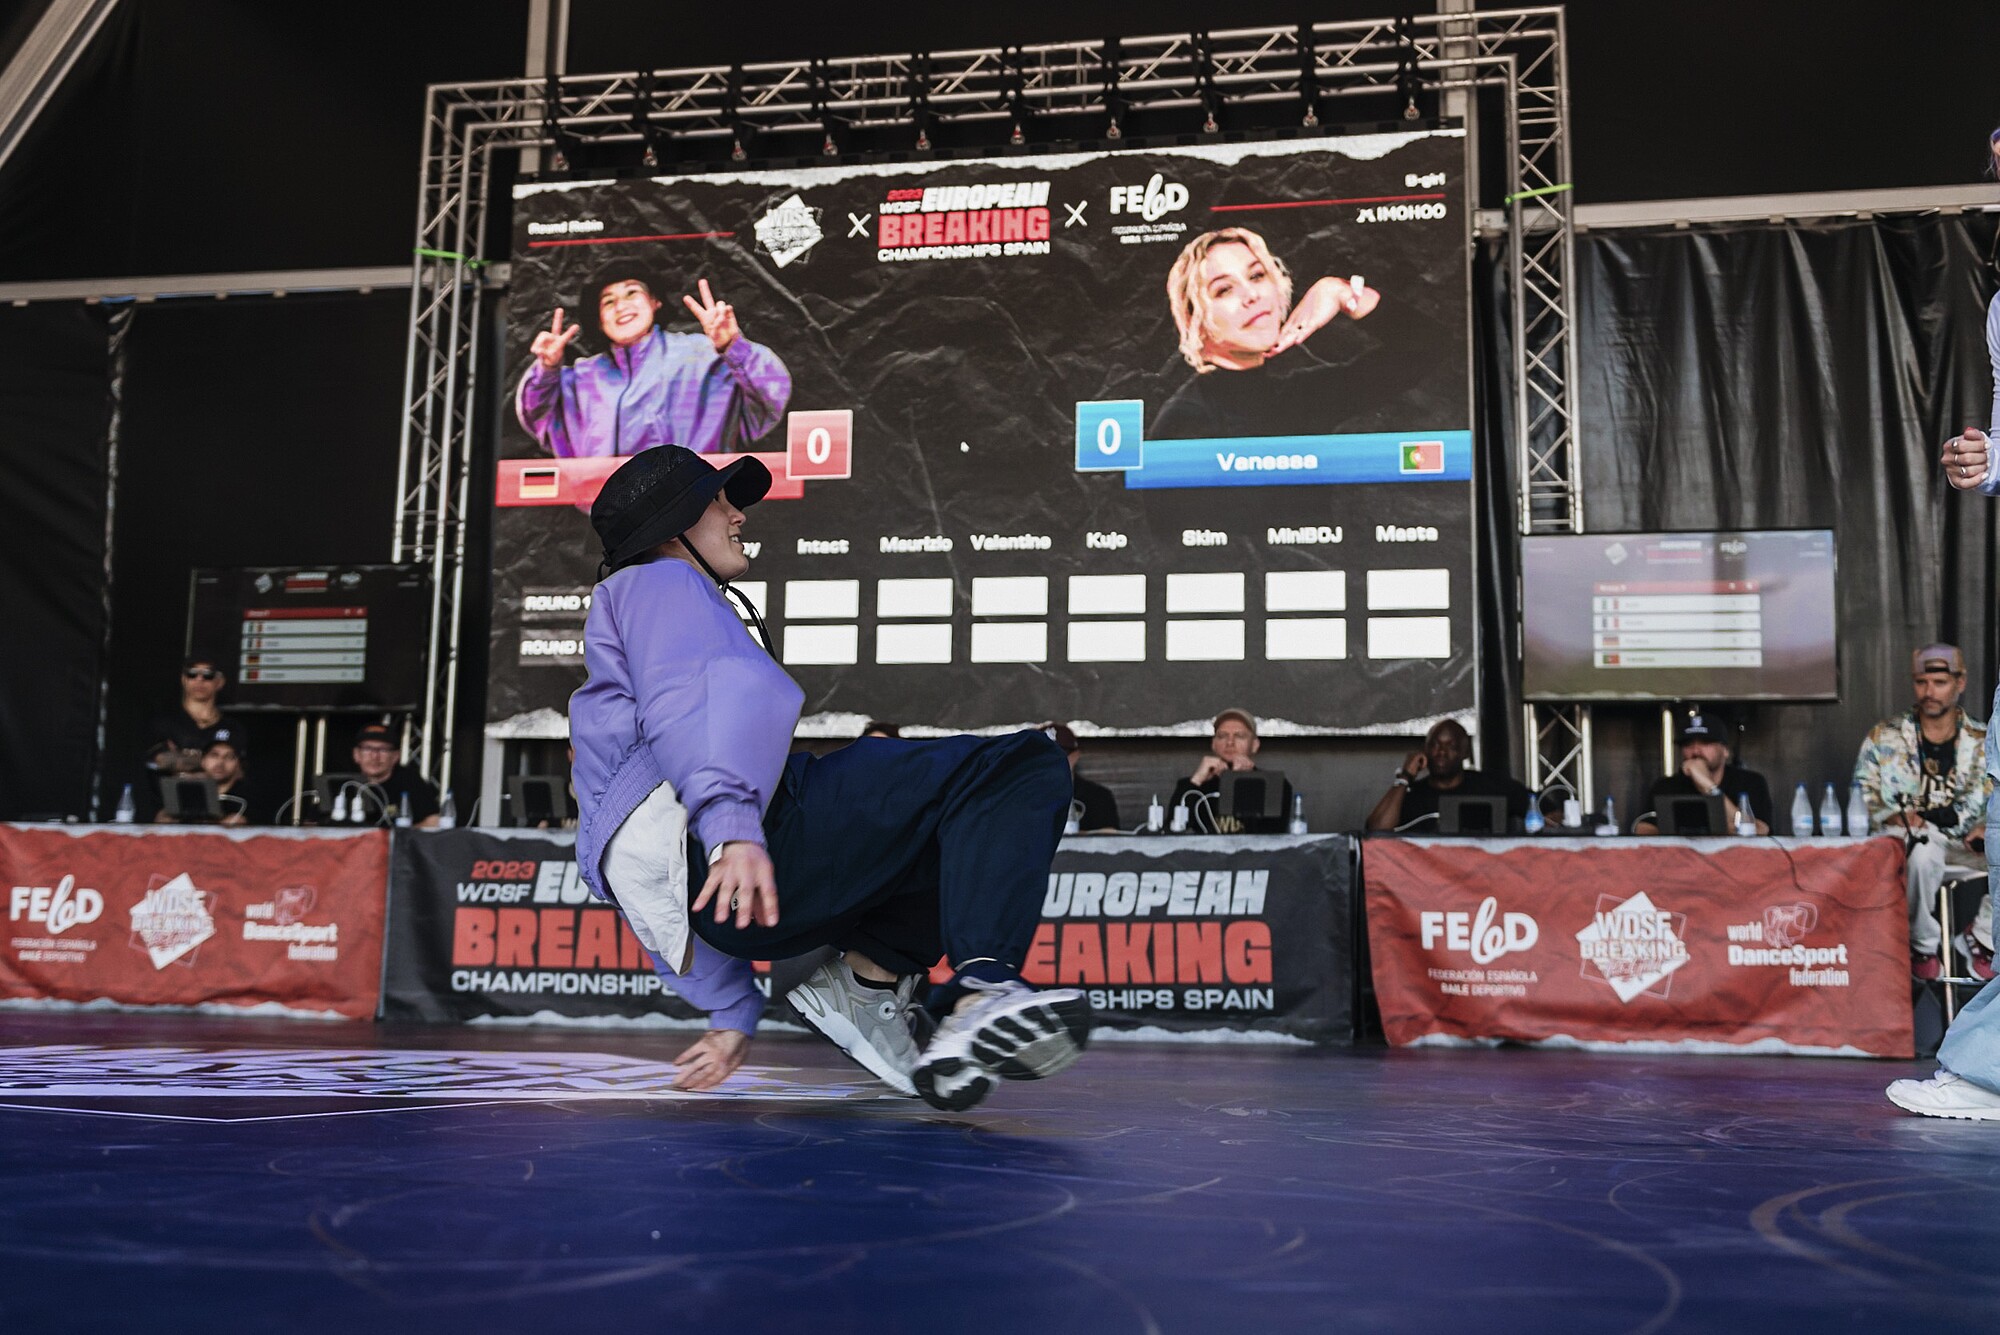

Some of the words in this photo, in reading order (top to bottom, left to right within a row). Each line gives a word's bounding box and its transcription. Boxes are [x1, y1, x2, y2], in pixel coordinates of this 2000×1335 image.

[879, 201, 921, 214] WDSF
[921, 181, 1050, 212] EUROPEAN
[878, 207, 1050, 248] BREAKING
[878, 243, 1002, 262] CHAMPIONSHIPS
[1003, 241, 1050, 256] SPAIN
[807, 427, 831, 464] 0
[1097, 418, 1122, 455] 0
[1216, 453, 1318, 471] Vanessa
[797, 538, 849, 555] Intact
[879, 535, 953, 553] Maurizio
[1086, 531, 1128, 550] Kujo
[1182, 529, 1228, 546] Skim
[525, 595, 581, 611] ROUND
[521, 640, 577, 655] ROUND
[471, 861, 536, 880] 2023
[456, 882, 531, 903] WDSF
[1041, 870, 1270, 918] UROPEAN
[1595, 911, 1672, 940] WDSF
[1727, 921, 1763, 941] world
[453, 907, 655, 970] BREA
[1580, 939, 1687, 960] BREAKING
[1020, 920, 1273, 985] EAKING
[1728, 943, 1848, 968] DanceSport
[1789, 967, 1849, 986] federation
[1184, 988, 1275, 1010] SPAIN
